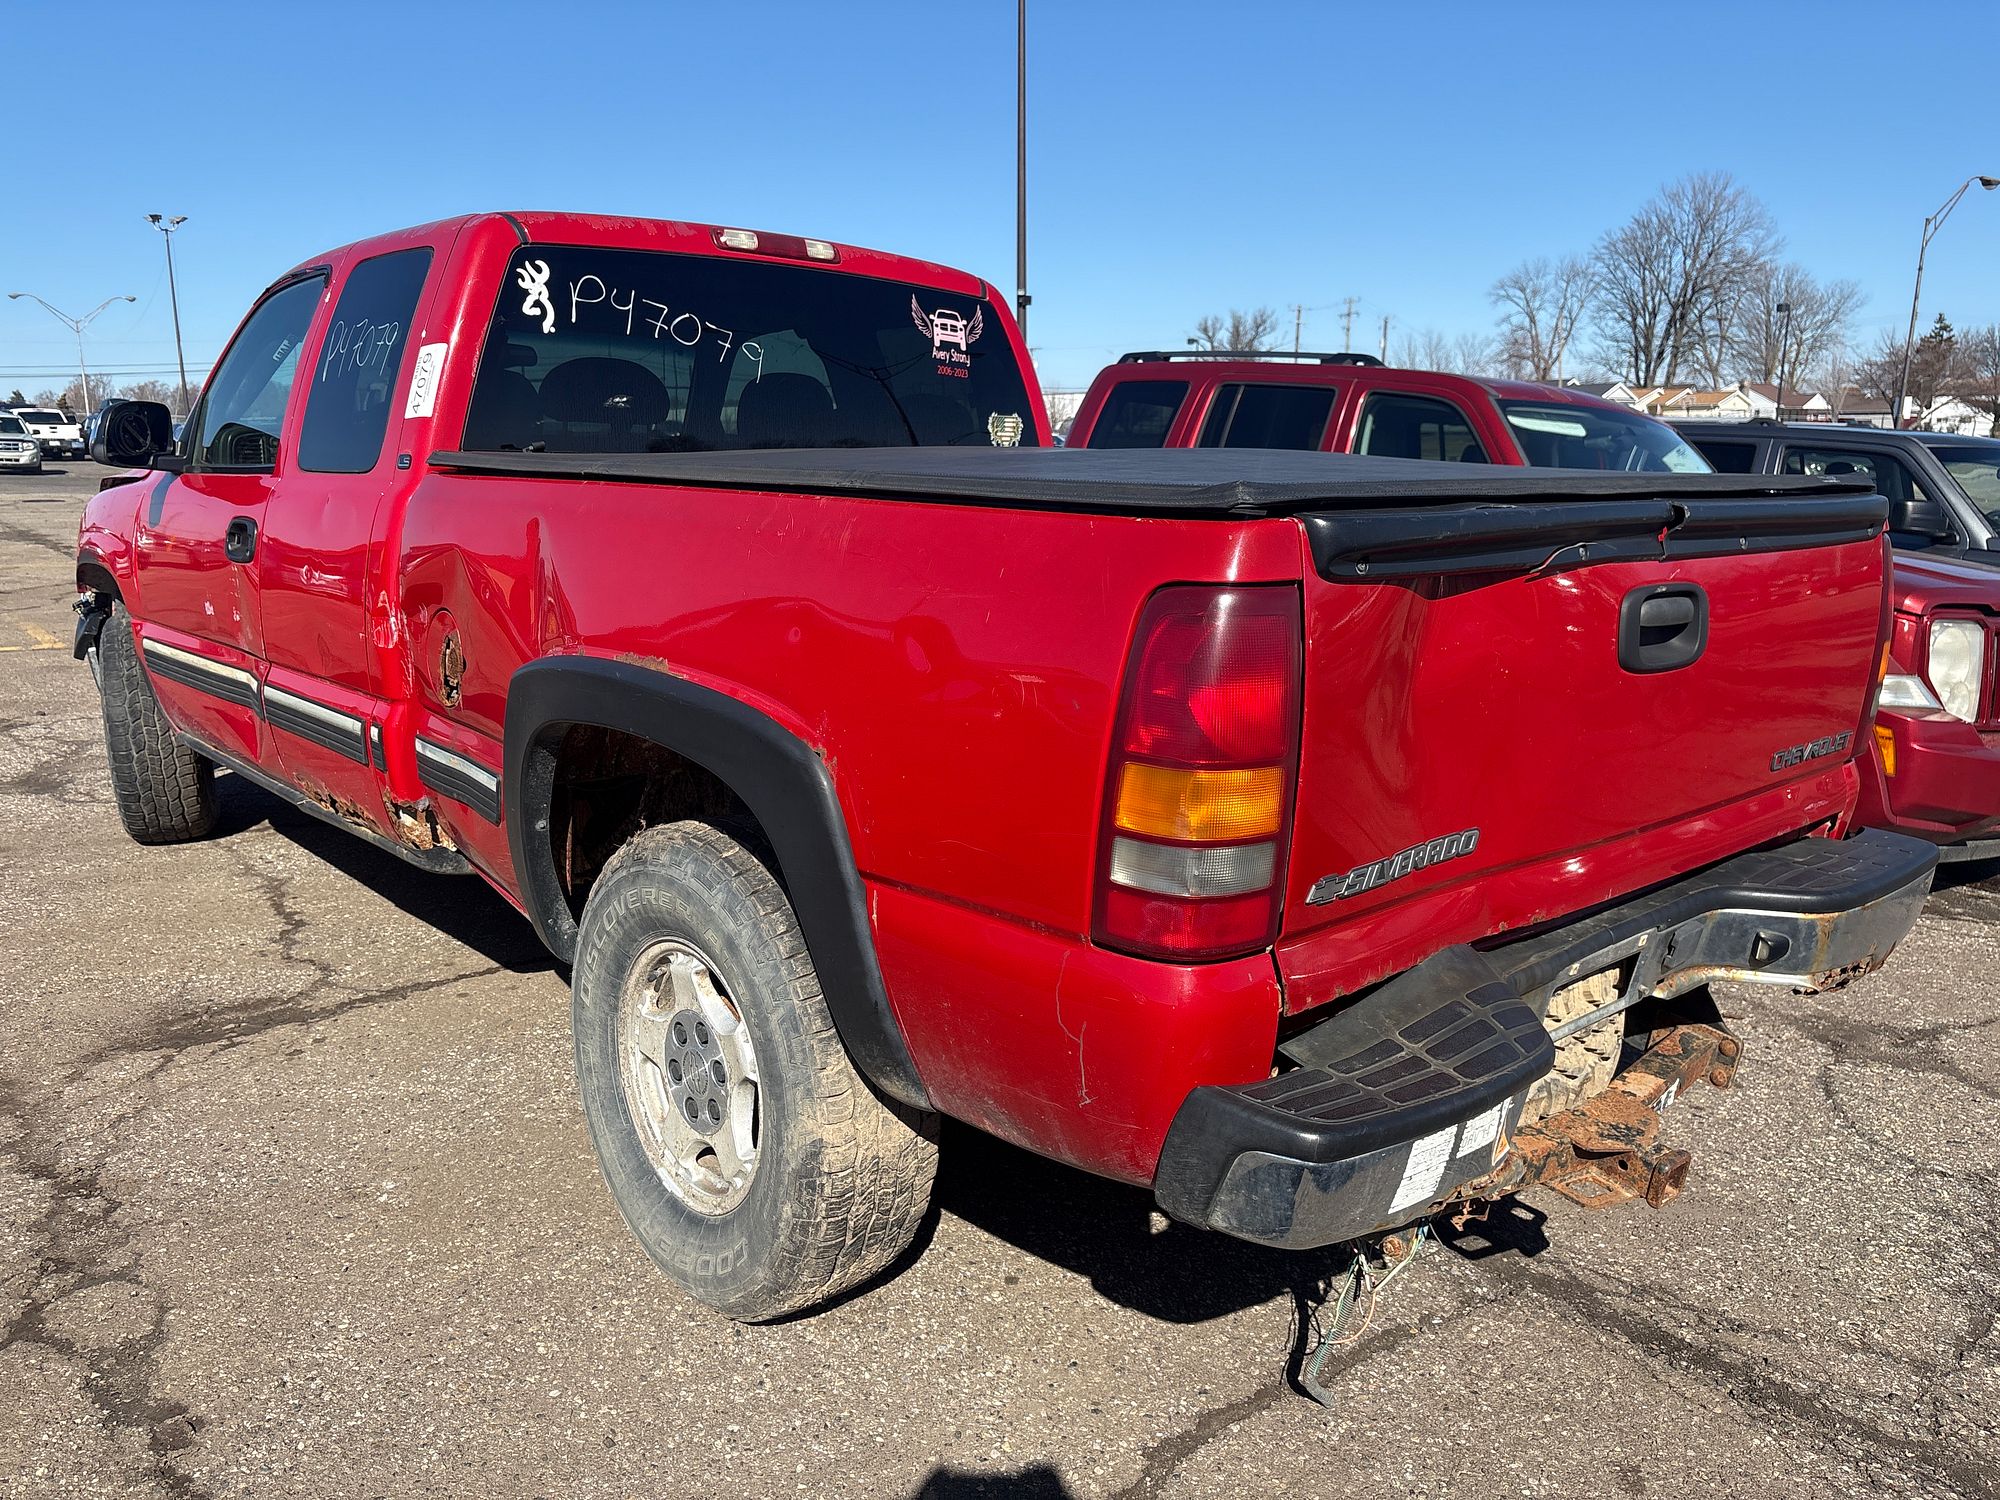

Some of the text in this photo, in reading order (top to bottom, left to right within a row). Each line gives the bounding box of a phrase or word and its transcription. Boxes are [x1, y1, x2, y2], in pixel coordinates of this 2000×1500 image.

[322, 318, 399, 382] P47079
[569, 275, 764, 384] P47079
[932, 346, 970, 367] Avery Strong
[412, 352, 432, 414] 47079
[1770, 730, 1854, 772] CHEVROLET
[1343, 827, 1481, 896] SILVERADO
[580, 886, 696, 1007] DISCOVERER
